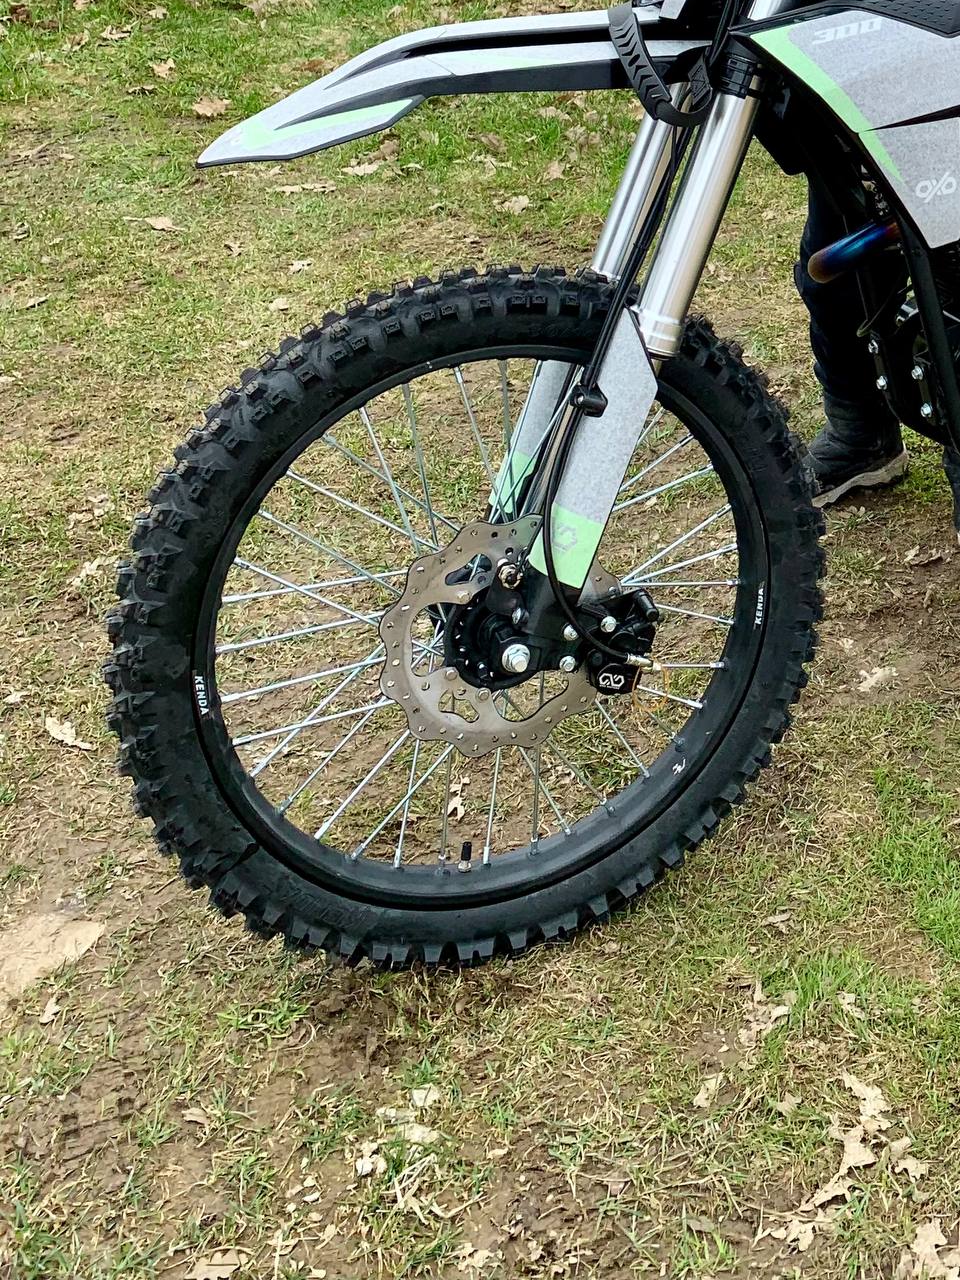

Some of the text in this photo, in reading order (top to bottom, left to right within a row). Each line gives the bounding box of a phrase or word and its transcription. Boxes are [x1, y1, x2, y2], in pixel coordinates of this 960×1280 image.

[812, 17, 882, 45] 300
[755, 588, 764, 625] KENDA
[194, 675, 209, 715] KENDA
